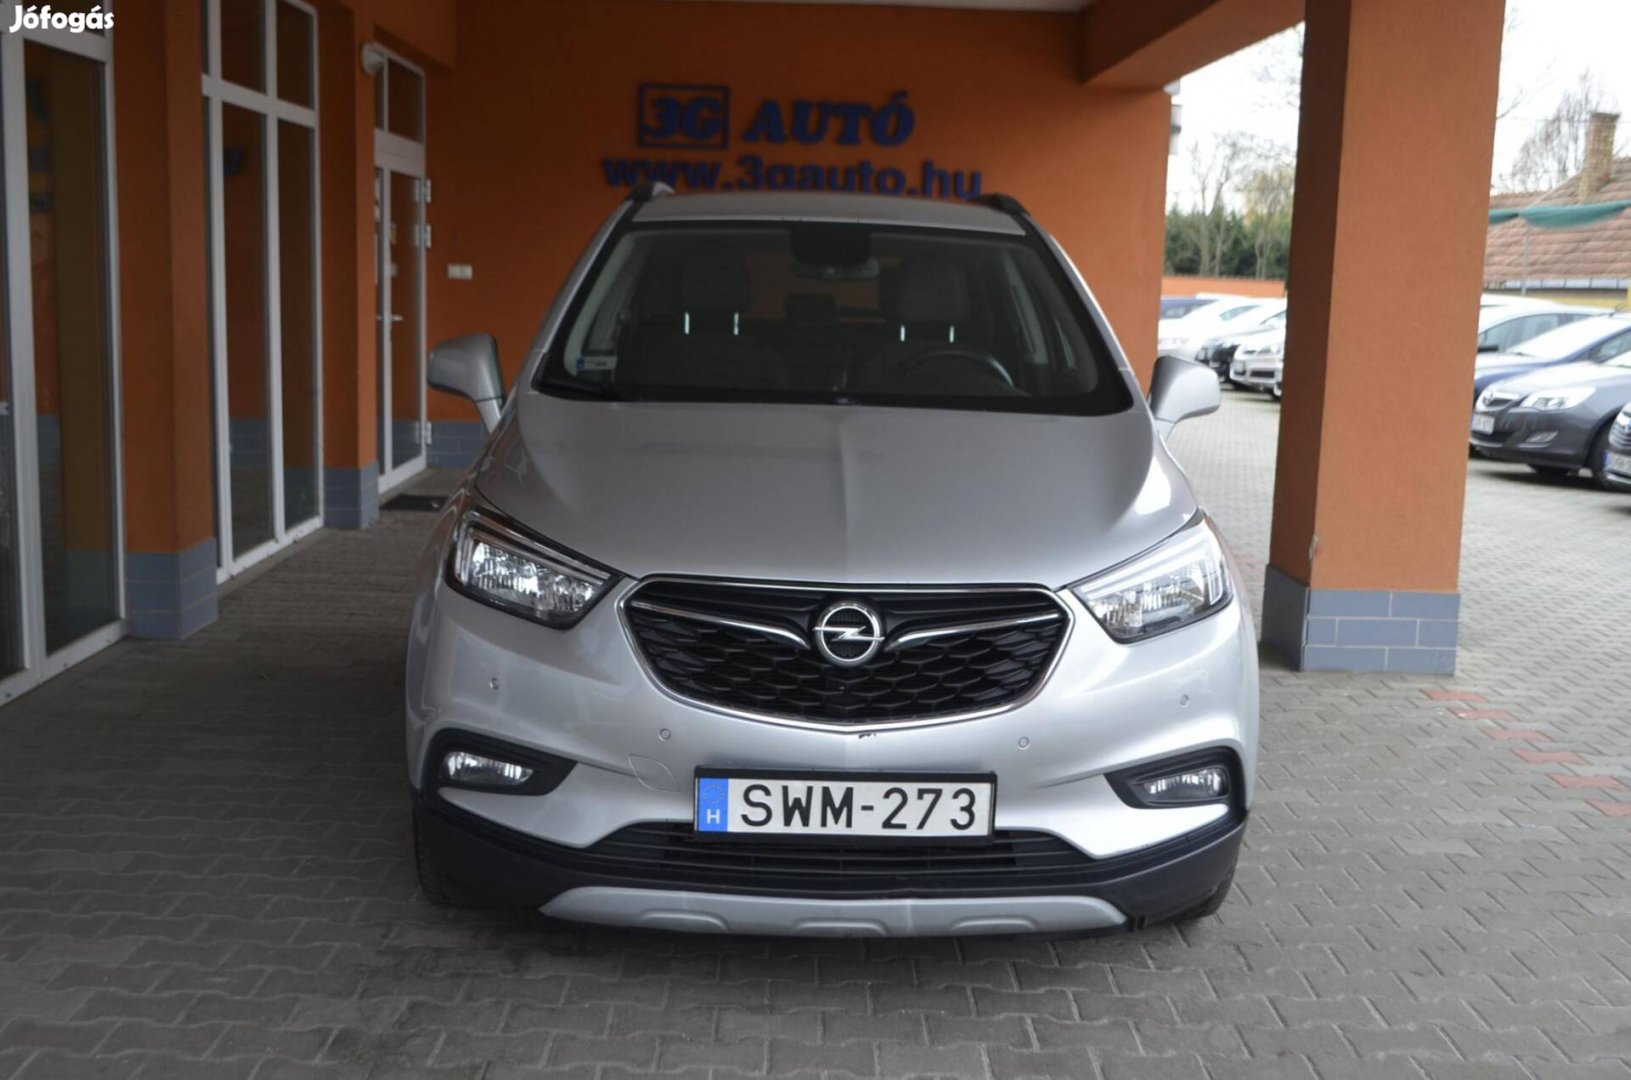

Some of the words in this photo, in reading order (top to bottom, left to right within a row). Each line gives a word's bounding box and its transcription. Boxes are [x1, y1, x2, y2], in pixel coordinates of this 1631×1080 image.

[641, 95, 722, 140] 3G
[741, 90, 916, 147] AUTÓ
[707, 809, 720, 824] H
[741, 784, 976, 830] SWM-273
